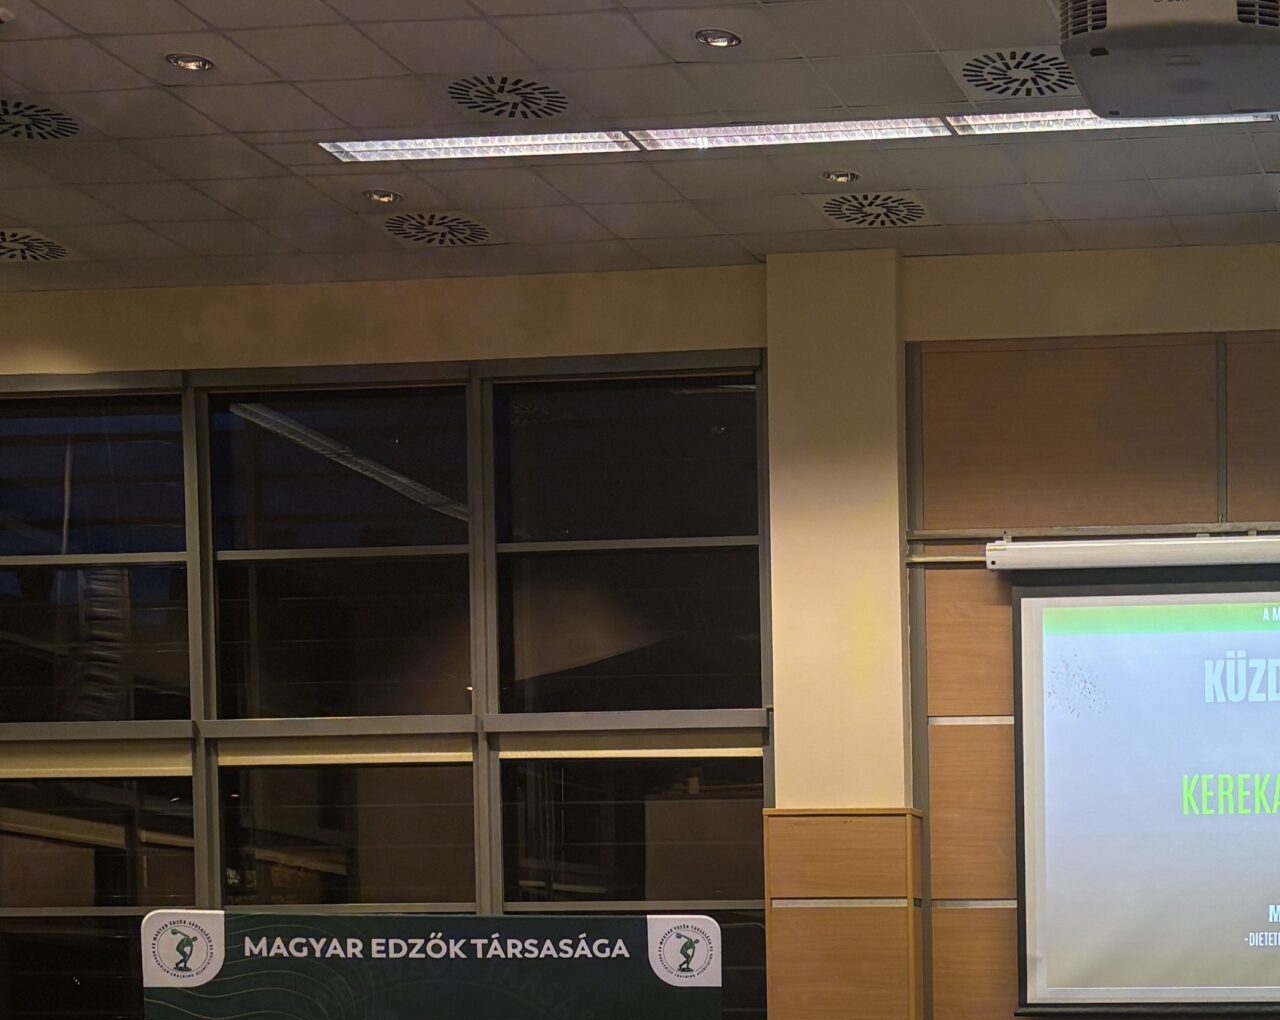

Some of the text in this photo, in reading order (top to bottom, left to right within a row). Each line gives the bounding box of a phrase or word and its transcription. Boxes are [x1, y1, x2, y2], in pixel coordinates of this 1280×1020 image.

[1263, 607, 1270, 621] A
[244, 932, 630, 958] MAGYAR EDZŐK TÁRSASÁGA
